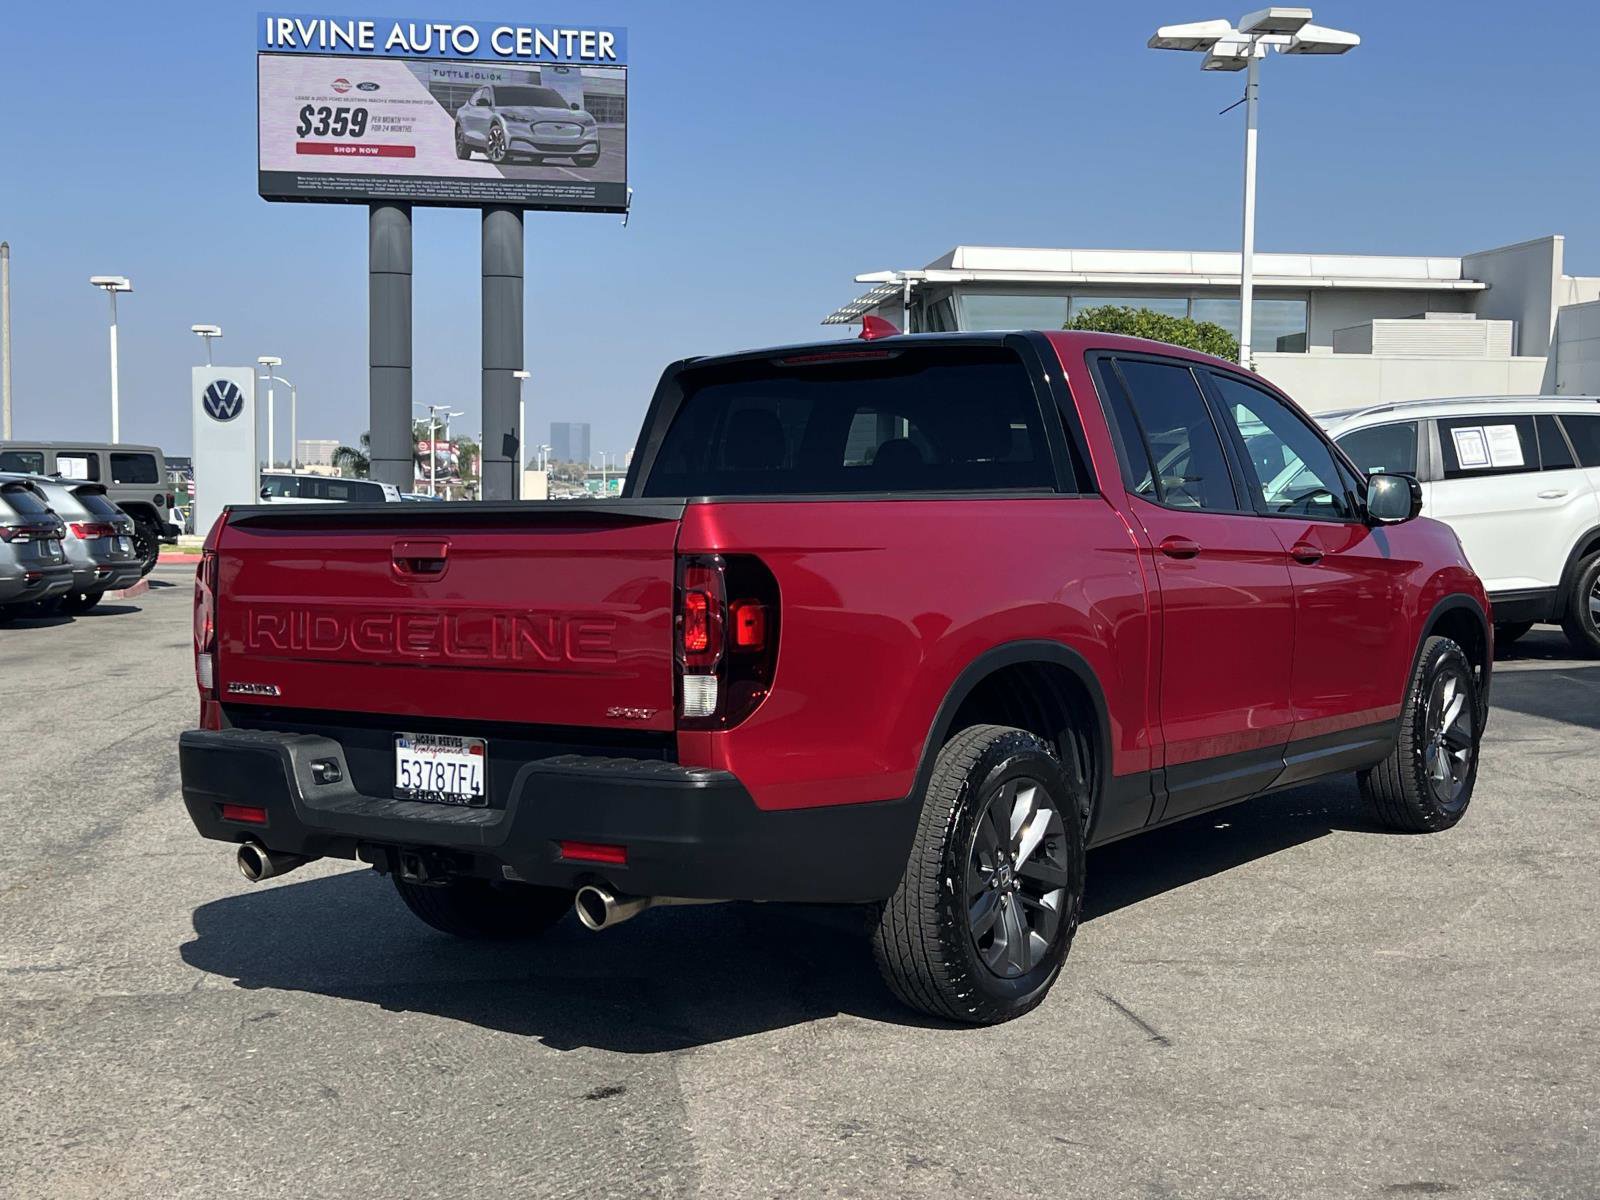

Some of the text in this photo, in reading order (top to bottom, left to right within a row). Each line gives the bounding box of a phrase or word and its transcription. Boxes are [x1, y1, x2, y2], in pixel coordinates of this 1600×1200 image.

[265, 17, 617, 60] IRVINE AUTO CENTER
[296, 104, 369, 138] $359
[382, 116, 401, 124] MONTH
[371, 124, 382, 132] FOR
[390, 125, 413, 133] MONTHS
[333, 146, 379, 155] SHOP NOW
[247, 608, 618, 664] RIDGELINE
[606, 706, 658, 719] SPORT
[415, 733, 463, 748] NORM REEVES
[400, 758, 481, 795] 53787F4
